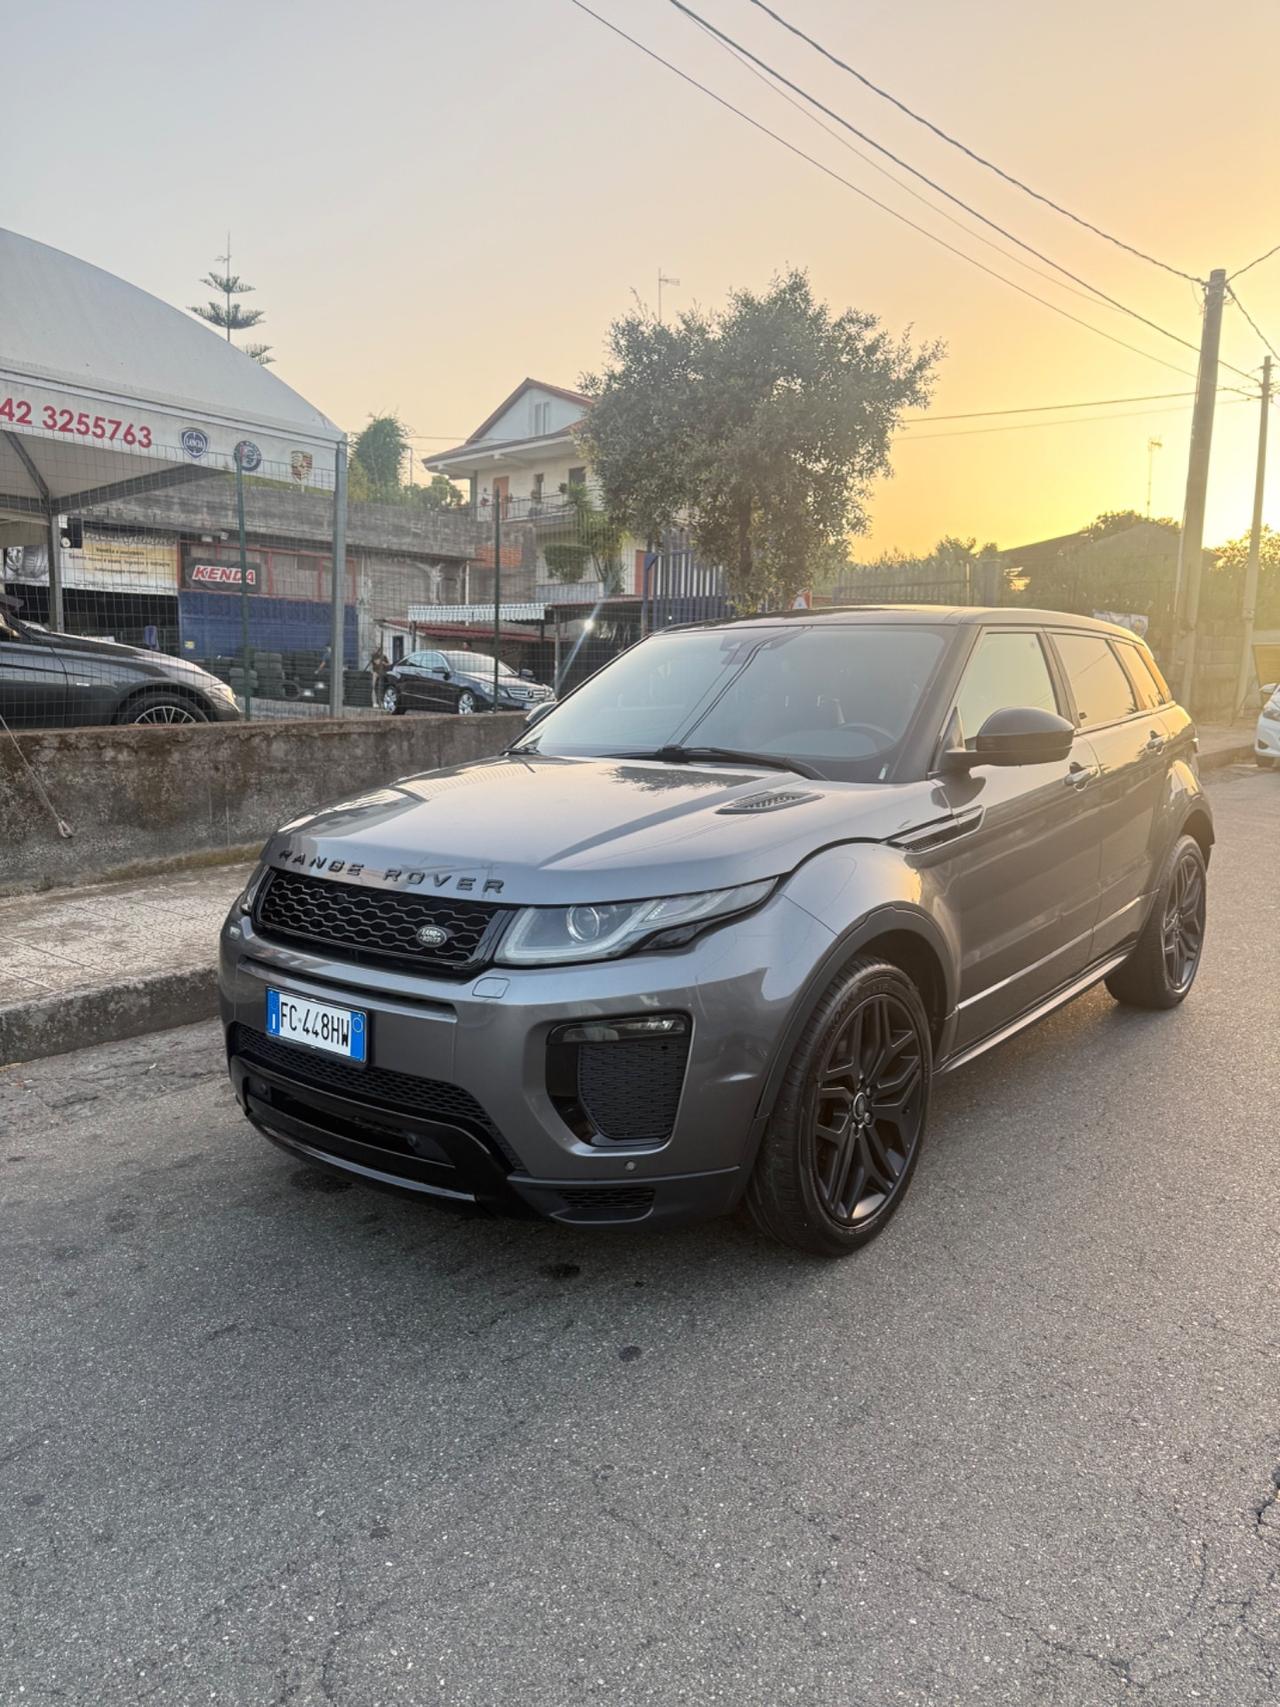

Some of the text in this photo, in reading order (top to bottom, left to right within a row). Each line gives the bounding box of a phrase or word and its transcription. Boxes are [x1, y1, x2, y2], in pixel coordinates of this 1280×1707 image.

[0, 398, 152, 448] 42 3255763
[192, 565, 256, 585] KENDA
[279, 850, 505, 894] RANGE ROVER
